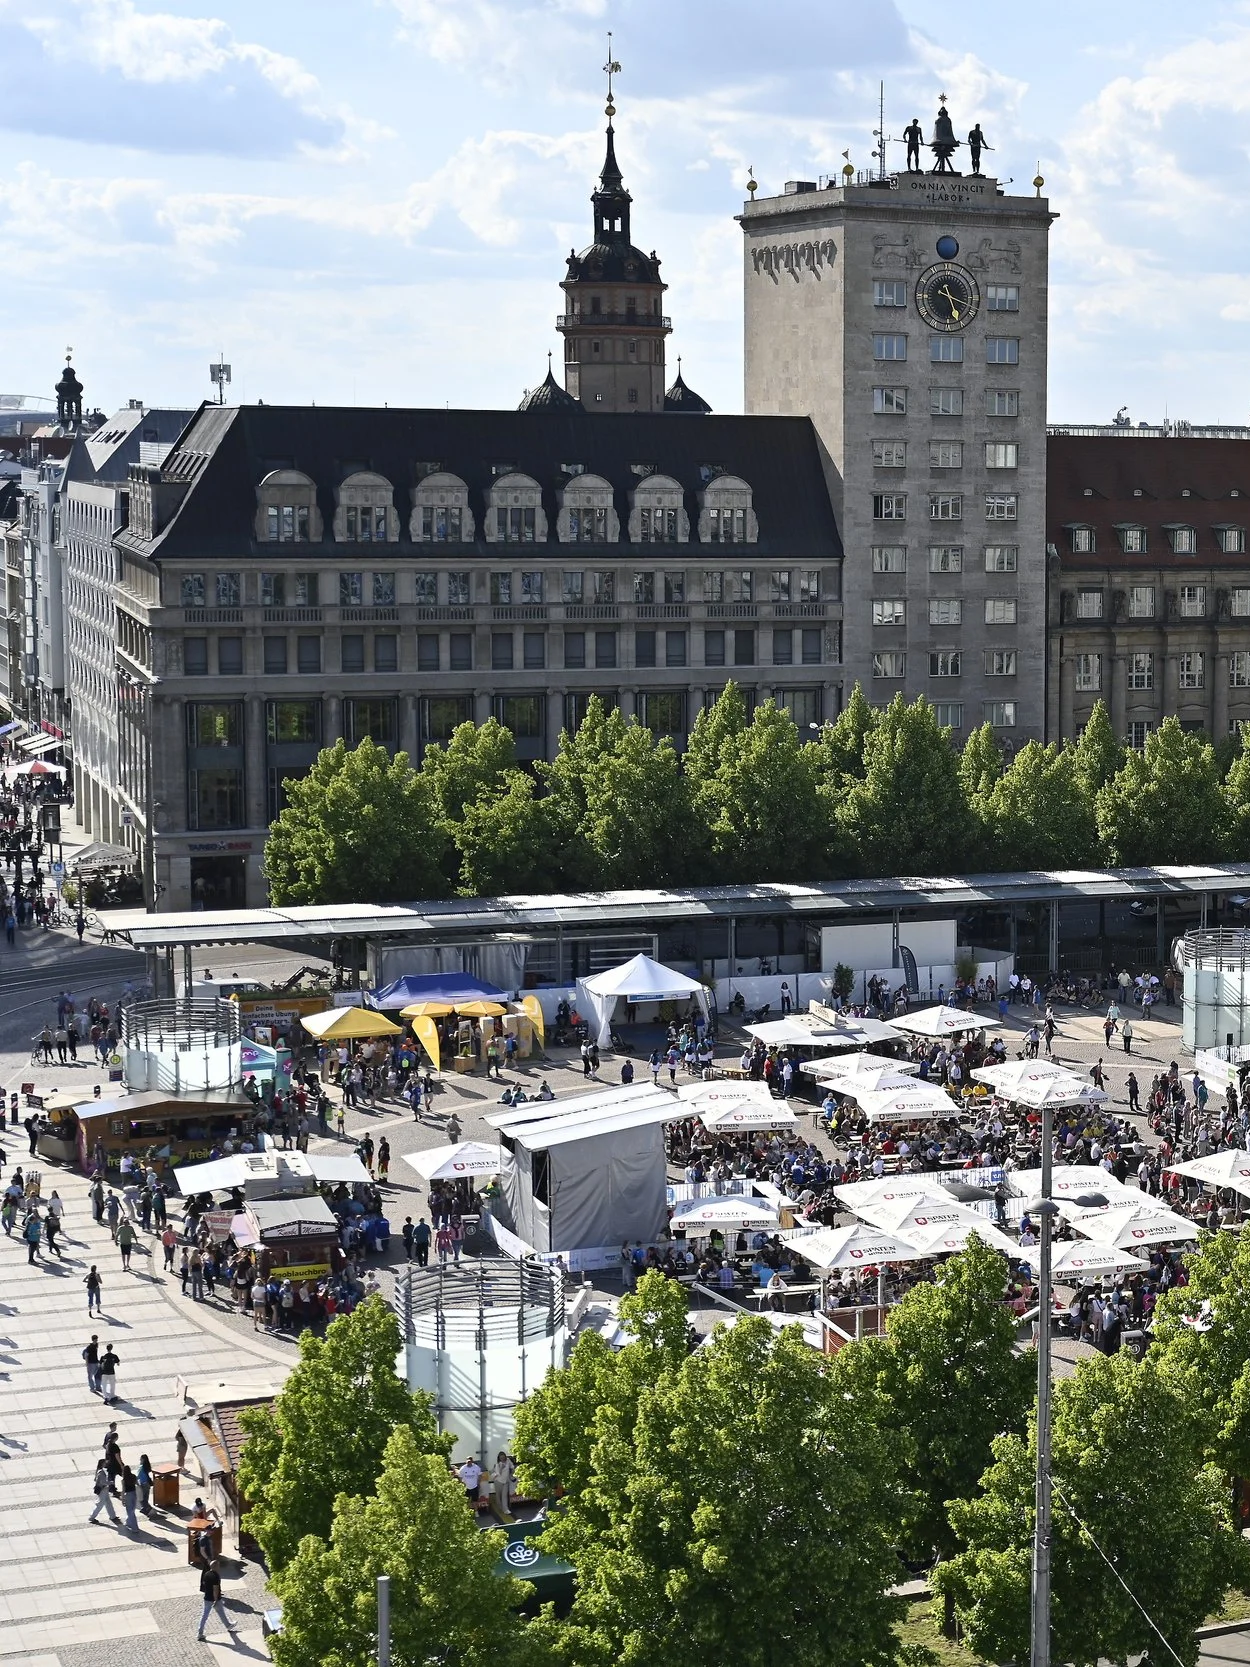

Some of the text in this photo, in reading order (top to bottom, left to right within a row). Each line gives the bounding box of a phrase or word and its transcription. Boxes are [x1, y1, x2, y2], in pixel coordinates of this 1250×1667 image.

[911, 182, 985, 193] OMNIA VINCIT
[932, 193, 964, 202] LABOR
[927, 1213, 960, 1221] SPATEN
[1144, 1225, 1177, 1234] SPATEN
[862, 1245, 896, 1254] SPATEN
